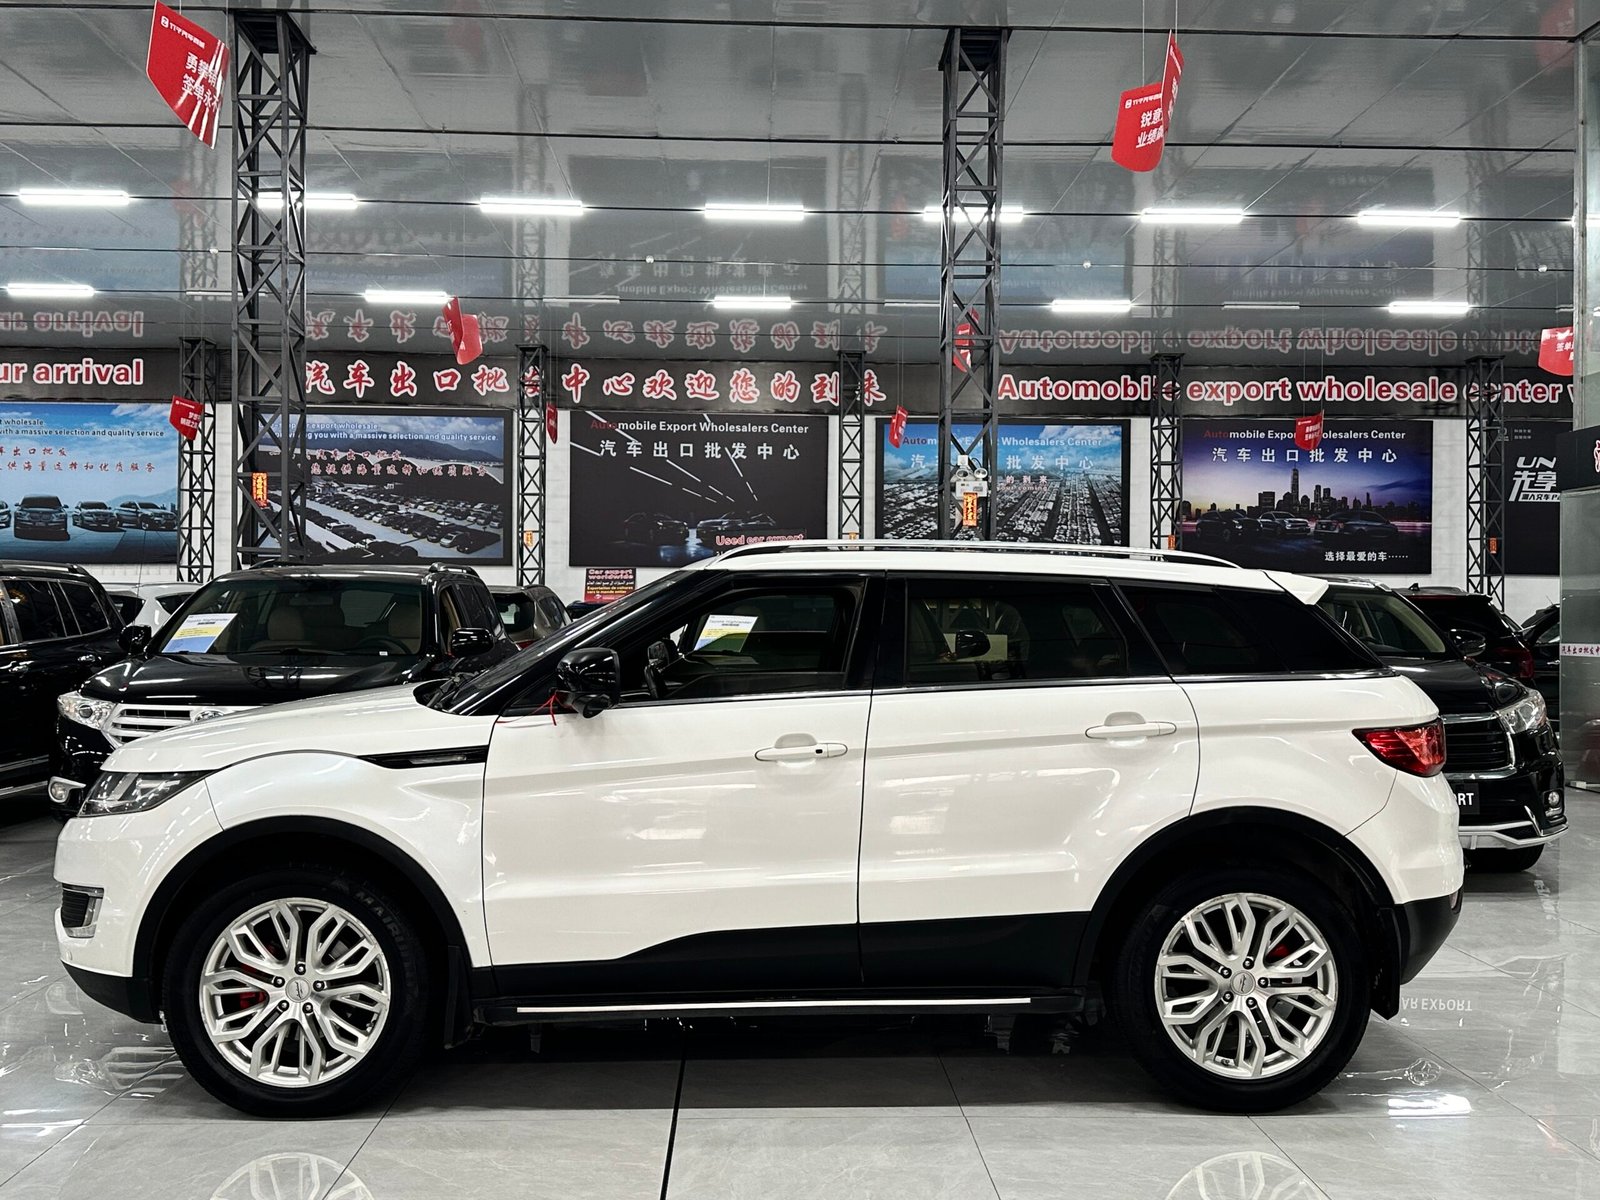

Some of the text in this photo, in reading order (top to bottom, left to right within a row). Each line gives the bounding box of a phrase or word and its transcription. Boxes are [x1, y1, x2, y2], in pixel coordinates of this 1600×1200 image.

[33, 357, 144, 385] arrival
[1187, 378, 1292, 406] export
[1297, 376, 1457, 401] wholesale
[311, 423, 339, 431] export
[590, 419, 809, 434] Automobile Export Wholesalers Center
[54, 428, 90, 436] selection
[92, 428, 106, 436] and
[108, 429, 135, 438] quality
[314, 432, 329, 440] you
[330, 431, 348, 440] with
[355, 432, 388, 440] massive
[388, 432, 424, 441] selection
[424, 433, 440, 441] and
[441, 433, 468, 442] quality
[1204, 430, 1266, 440] Automobile
[1371, 430, 1406, 440] Center
[1001, 436, 1065, 447] Wholesalers
[1067, 436, 1102, 447] Center
[600, 439, 800, 460] 汽车出口批发中心
[1212, 447, 1398, 463] 汽车出口批发中心
[1516, 457, 1557, 469] UN
[716, 534, 745, 546] Used
[604, 568, 633, 576] export
